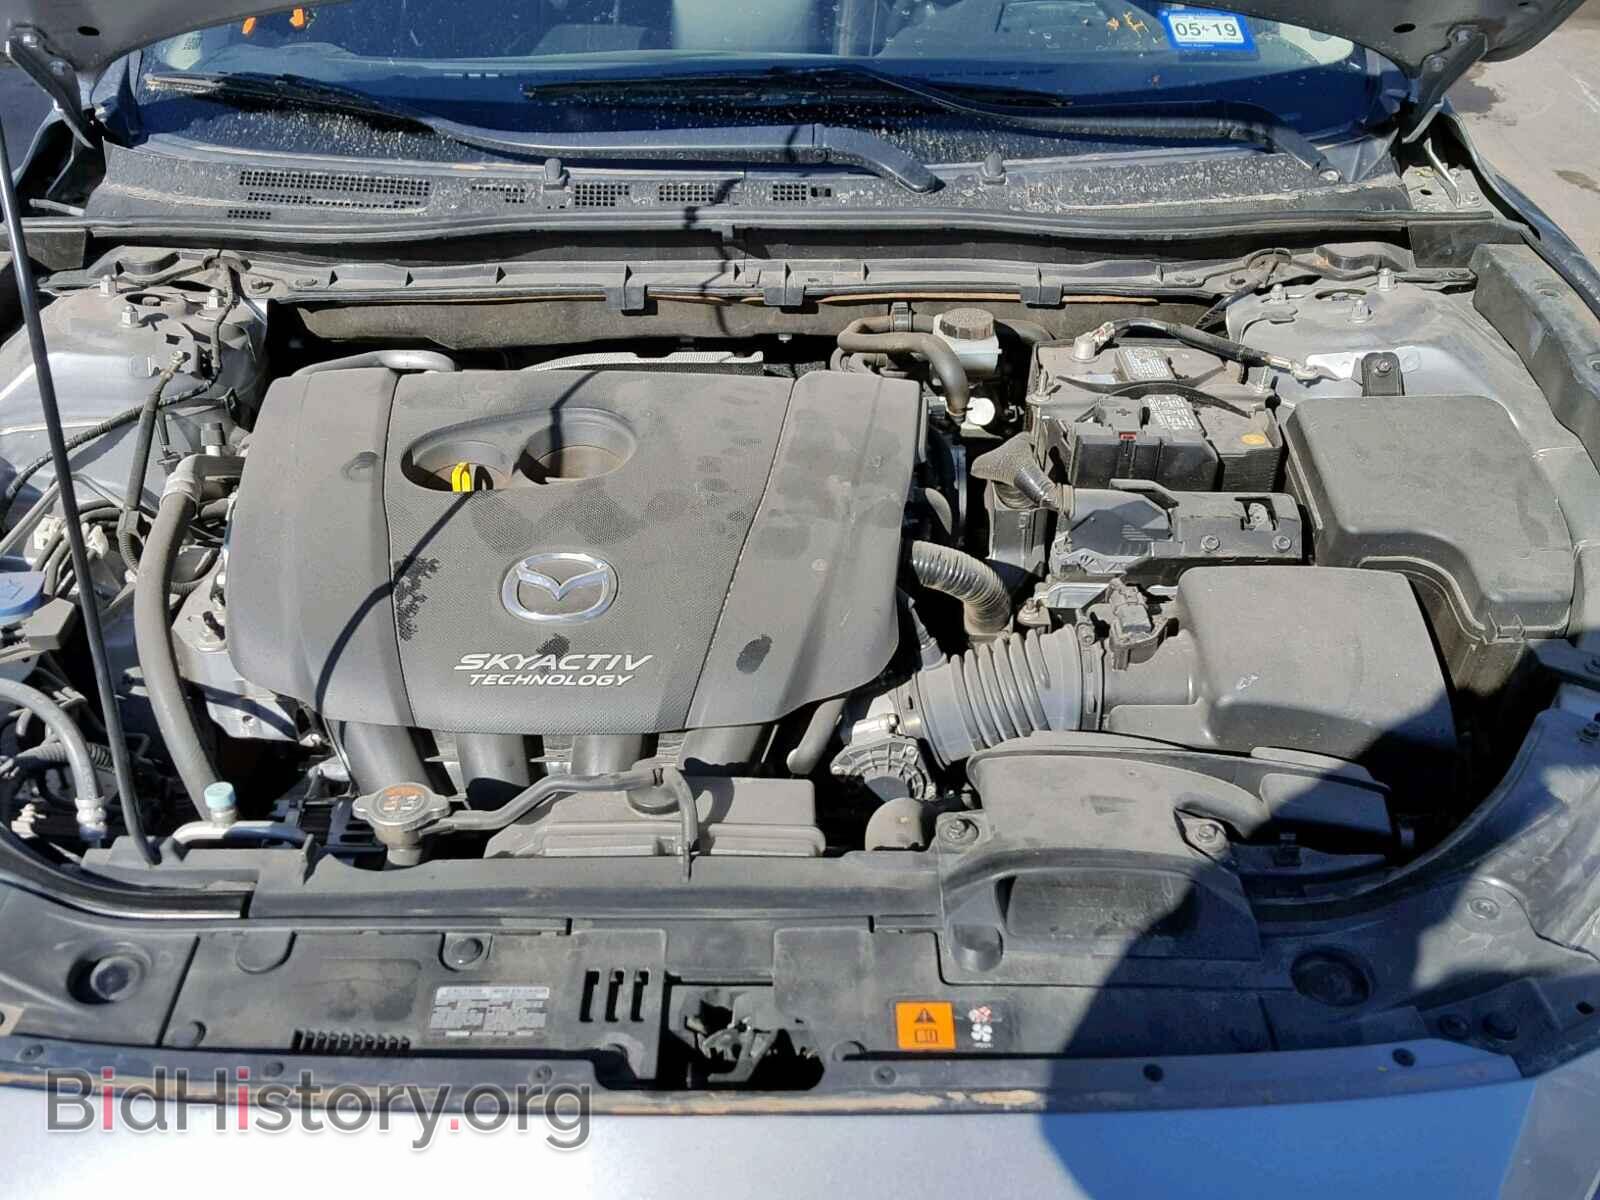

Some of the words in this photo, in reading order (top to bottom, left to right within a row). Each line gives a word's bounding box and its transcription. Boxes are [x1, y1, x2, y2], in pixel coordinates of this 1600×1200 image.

[1175, 22, 1201, 37] 05
[1211, 23, 1237, 37] 19
[454, 653, 654, 672] SKYACTIV
[468, 674, 634, 687] TECHNOLOGY
